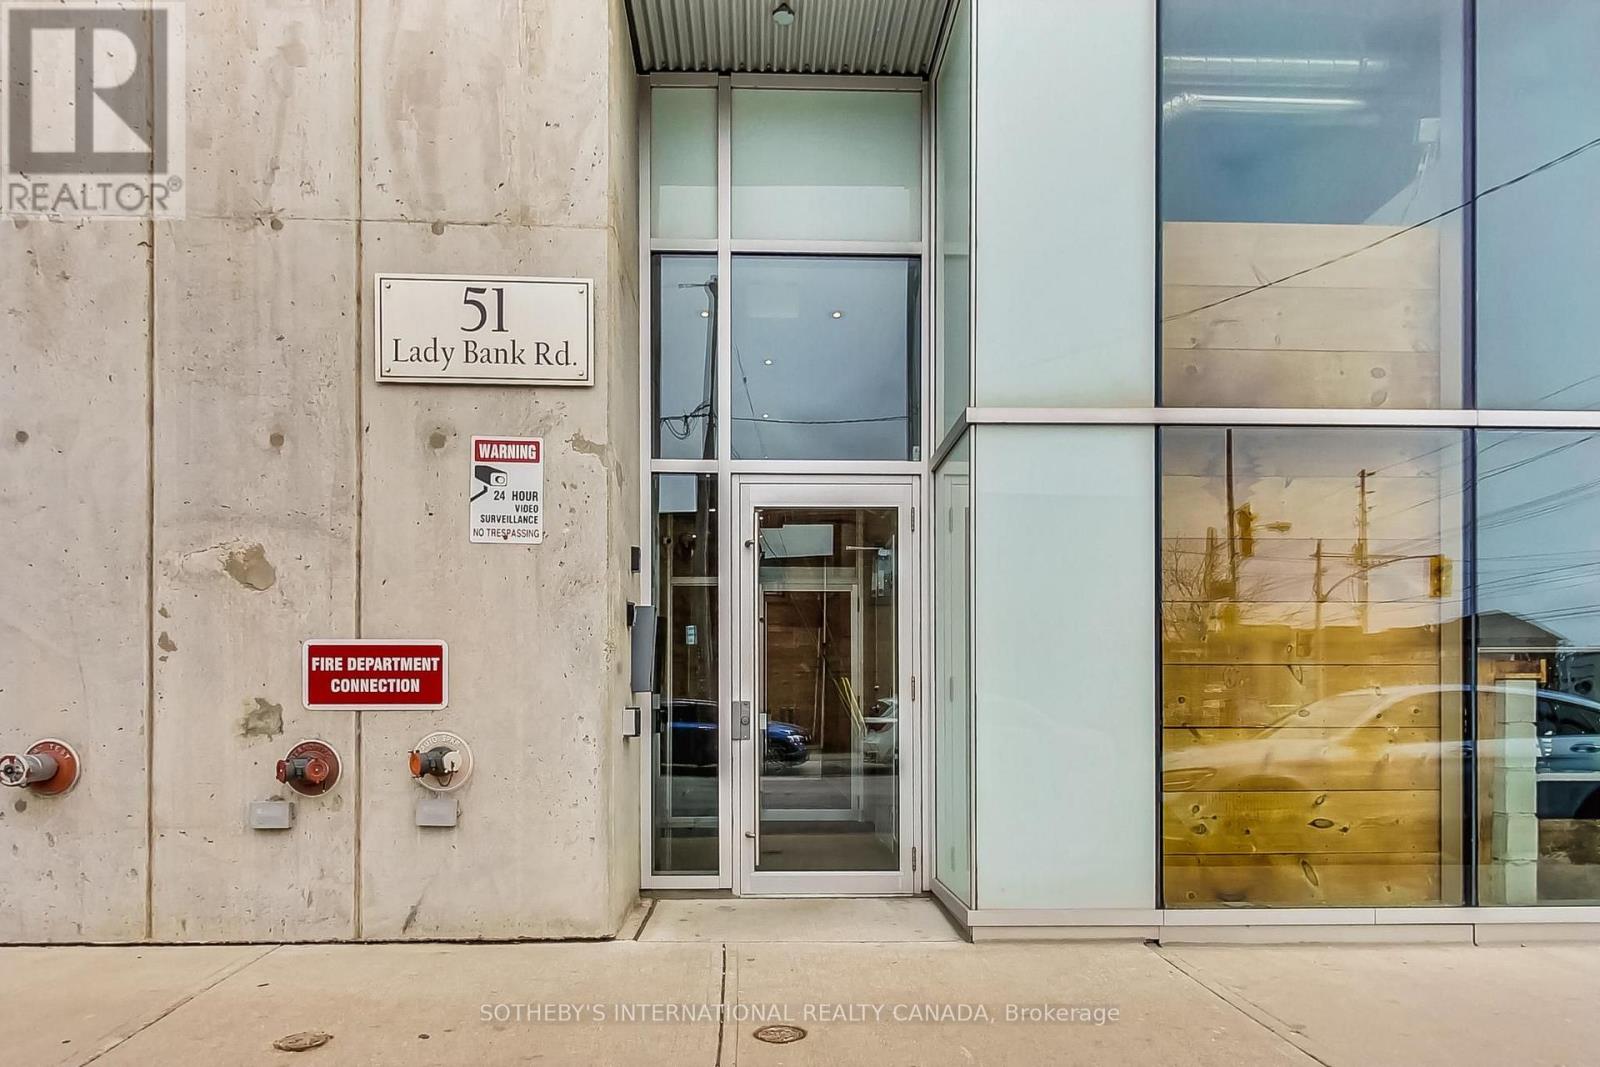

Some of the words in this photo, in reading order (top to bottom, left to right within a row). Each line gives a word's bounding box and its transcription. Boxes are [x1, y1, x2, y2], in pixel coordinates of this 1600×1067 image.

[460, 286, 509, 333] 51
[392, 337, 455, 371] Lady
[463, 339, 526, 365] Bank
[534, 341, 577, 366] Rd.
[479, 443, 537, 460] WARNING
[493, 490, 506, 501] 24
[511, 490, 539, 502] HOUR
[514, 504, 539, 514] VIDEO
[480, 514, 539, 525] SURVEILLANCE
[473, 528, 485, 537] NO
[487, 528, 540, 538] TRESPASSING
[311, 656, 344, 672] FIRE
[347, 656, 441, 672] DEPARTMENT
[330, 678, 420, 693] CONNECTION
